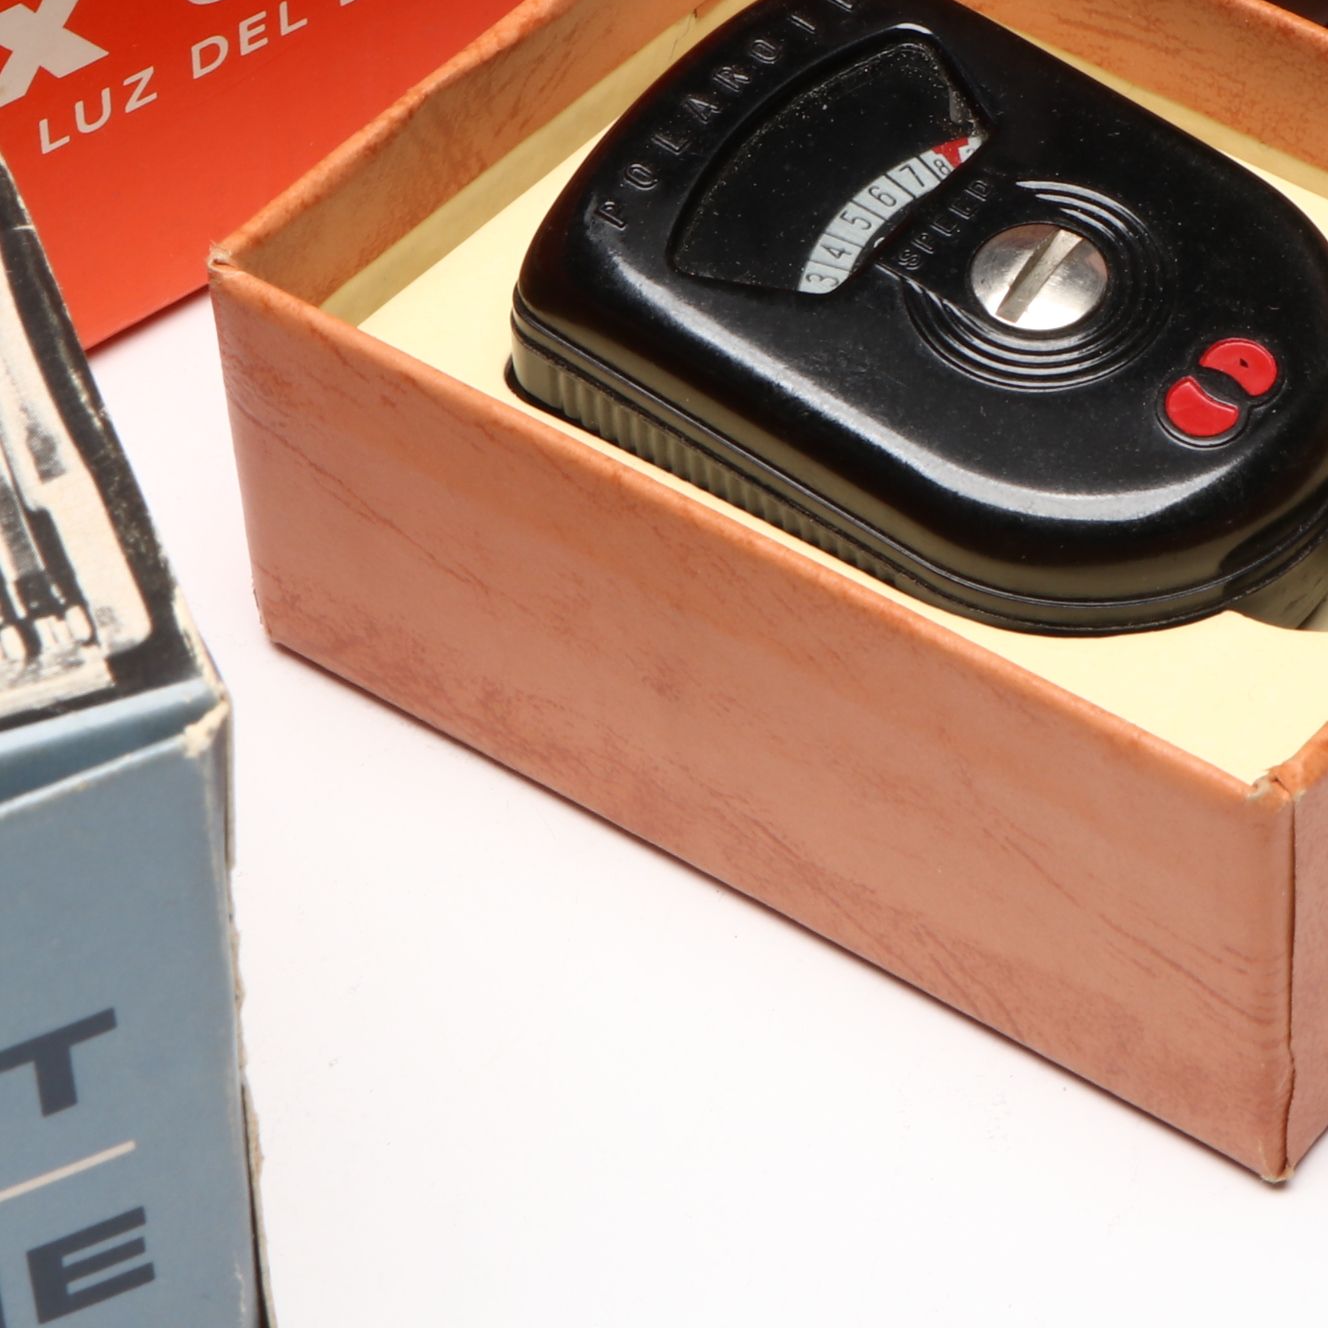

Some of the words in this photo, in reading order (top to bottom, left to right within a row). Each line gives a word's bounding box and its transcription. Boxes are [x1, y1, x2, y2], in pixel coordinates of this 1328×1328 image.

[38, 65, 159, 155] LUZ
[190, 0, 308, 80] DEL
[898, 178, 994, 271] SPEED
[0, 1205, 156, 1326] E
